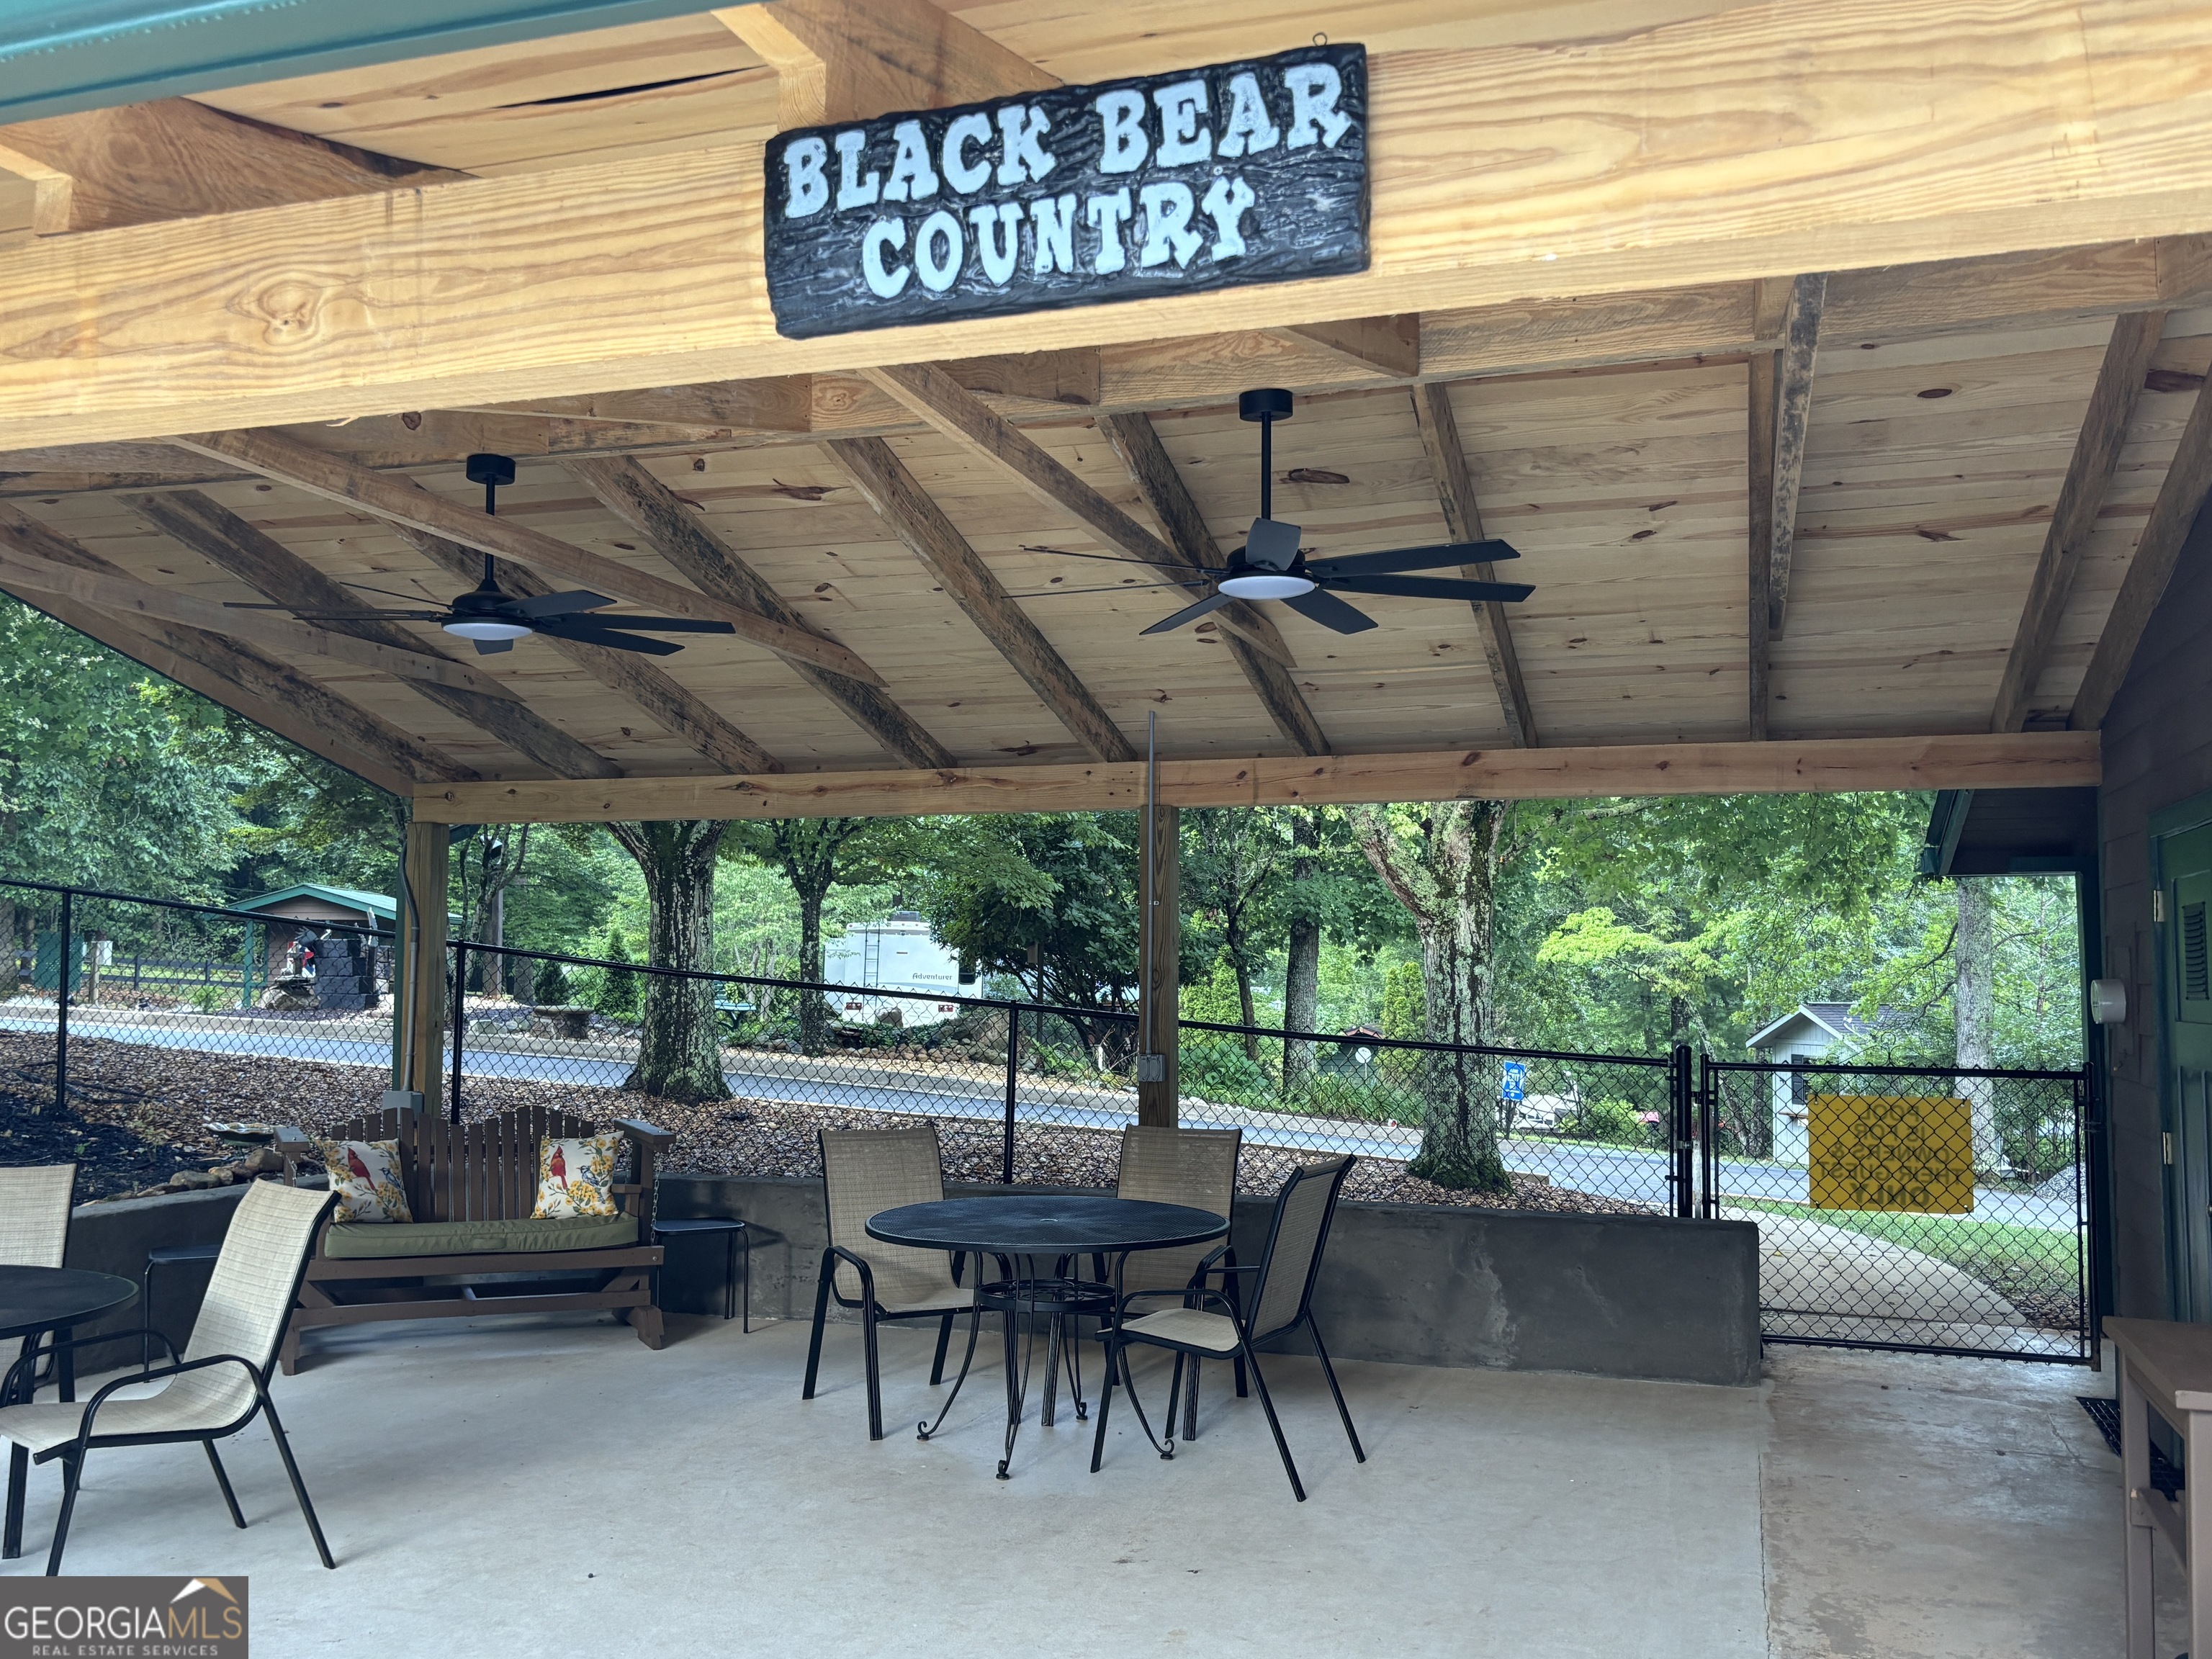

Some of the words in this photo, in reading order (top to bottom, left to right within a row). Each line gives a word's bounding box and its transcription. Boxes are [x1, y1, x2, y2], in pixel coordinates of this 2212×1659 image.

[783, 104, 1057, 218] BLACK
[1096, 63, 1352, 174] BEAR
[863, 176, 1255, 297] COUNTRY
